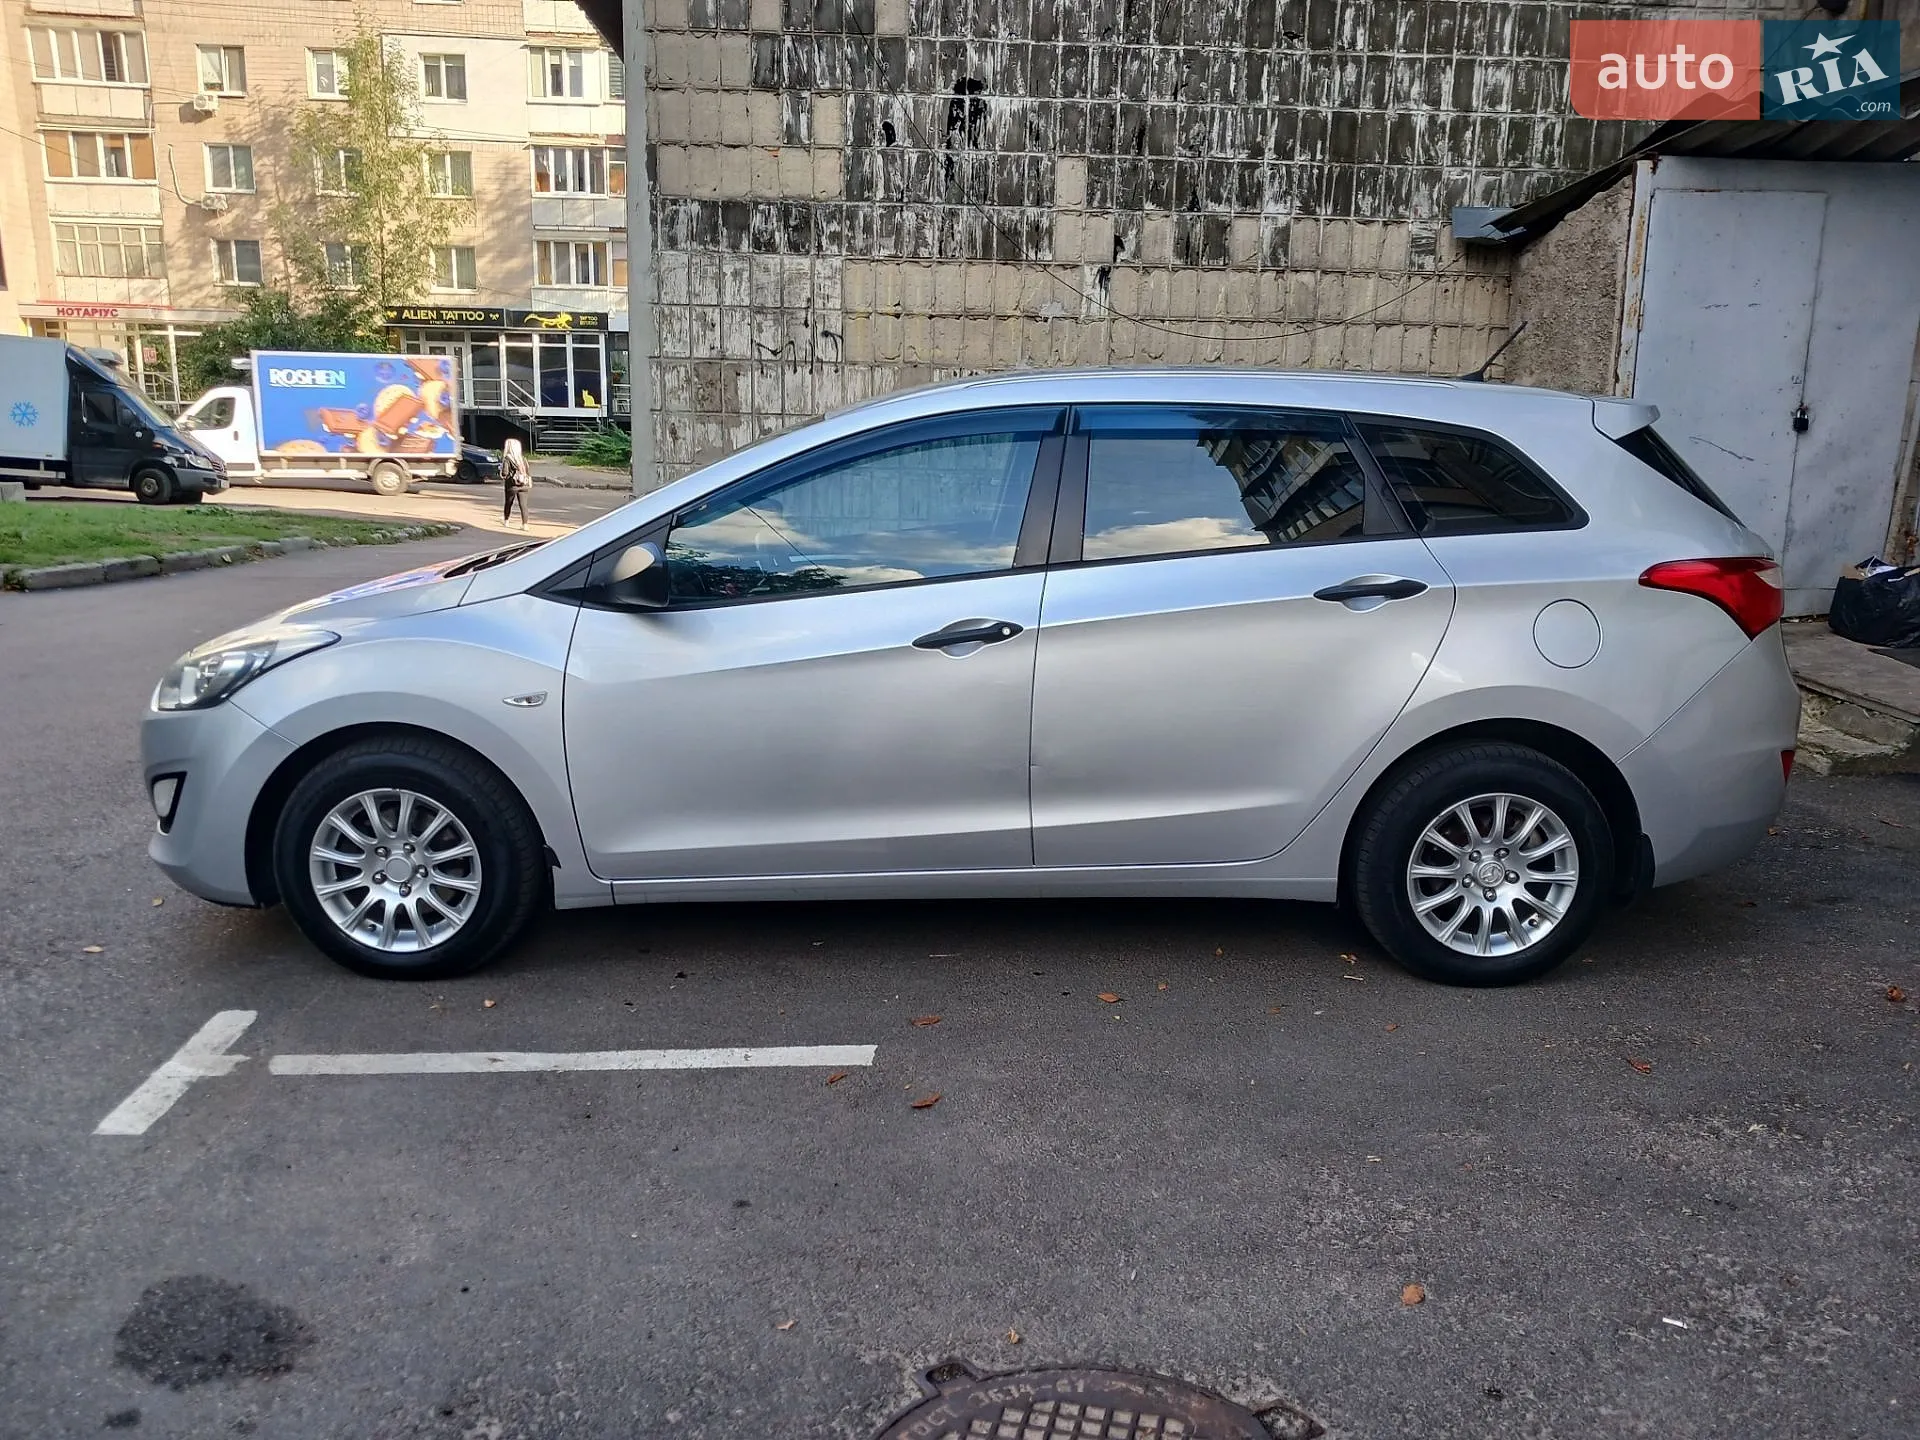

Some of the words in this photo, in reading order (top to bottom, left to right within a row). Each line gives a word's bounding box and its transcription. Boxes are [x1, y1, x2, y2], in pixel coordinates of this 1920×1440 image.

[56, 307, 119, 317] НОТАРІУС
[402, 309, 437, 320] ALIEN
[440, 310, 485, 321] TATTOO
[268, 368, 346, 387] ROSHEN
